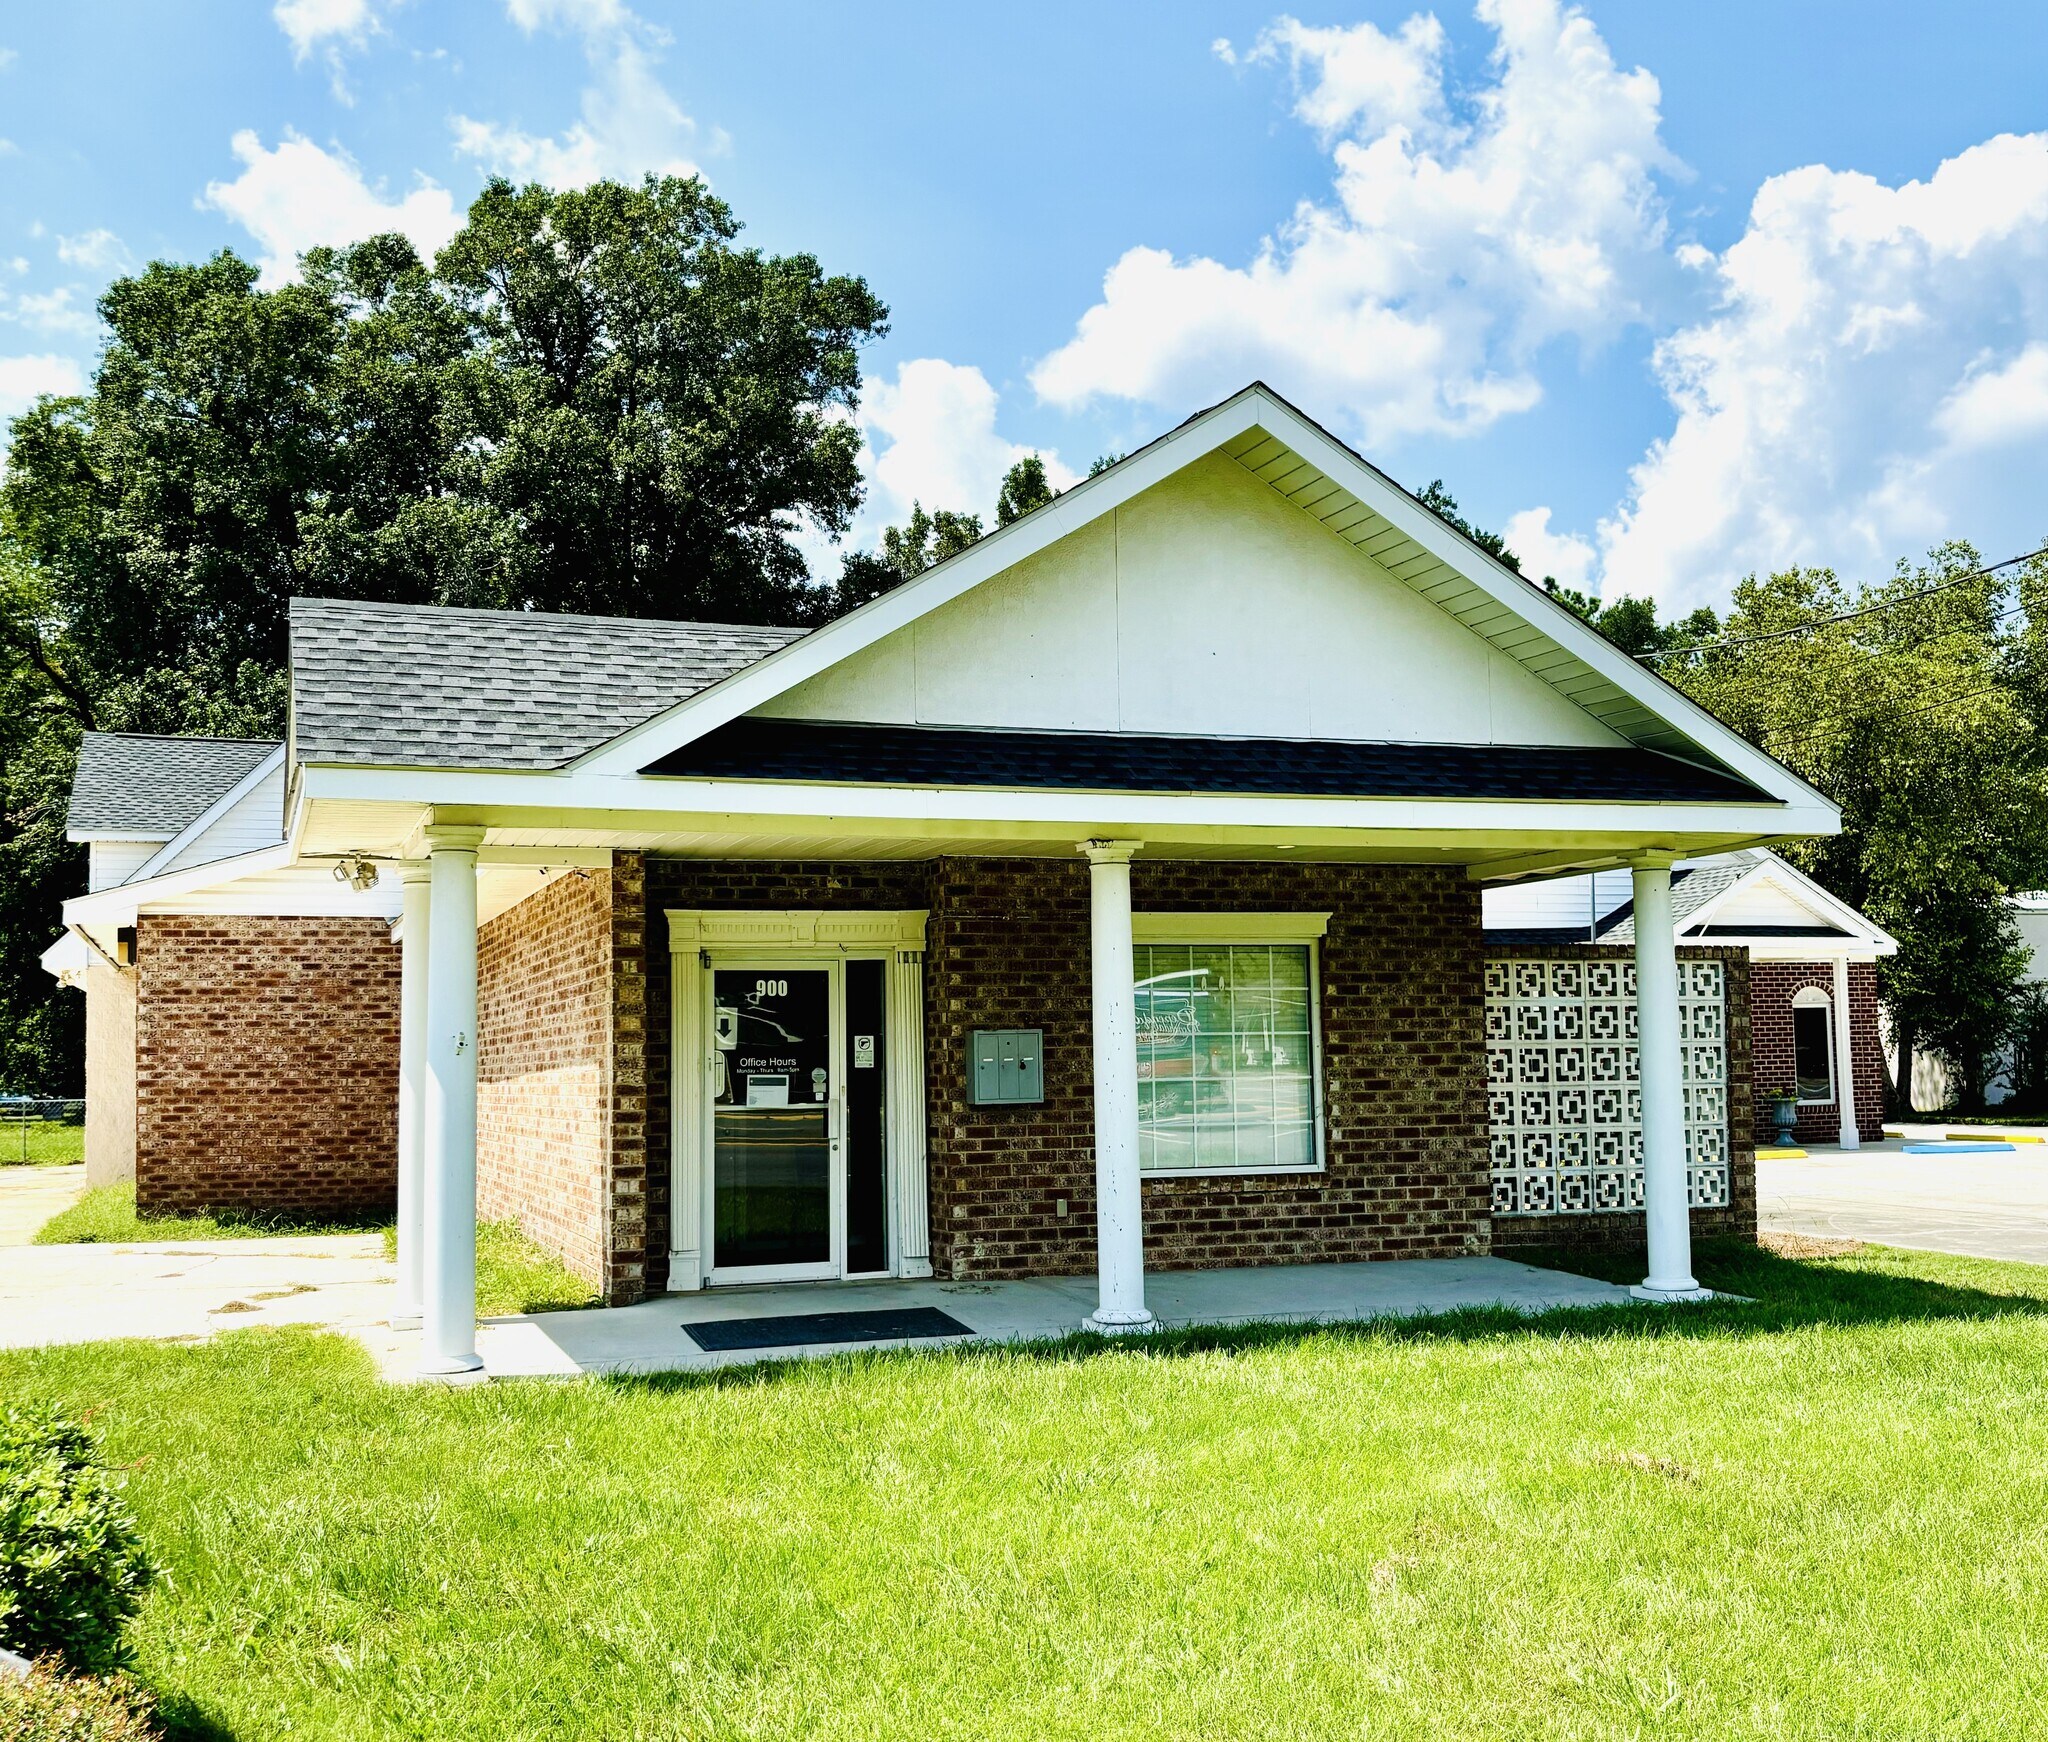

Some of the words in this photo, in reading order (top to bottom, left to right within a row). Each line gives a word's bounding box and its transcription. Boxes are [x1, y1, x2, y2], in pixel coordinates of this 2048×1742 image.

[756, 980, 788, 997] 900
[739, 1057, 767, 1067] Office
[769, 1057, 797, 1066] Hours
